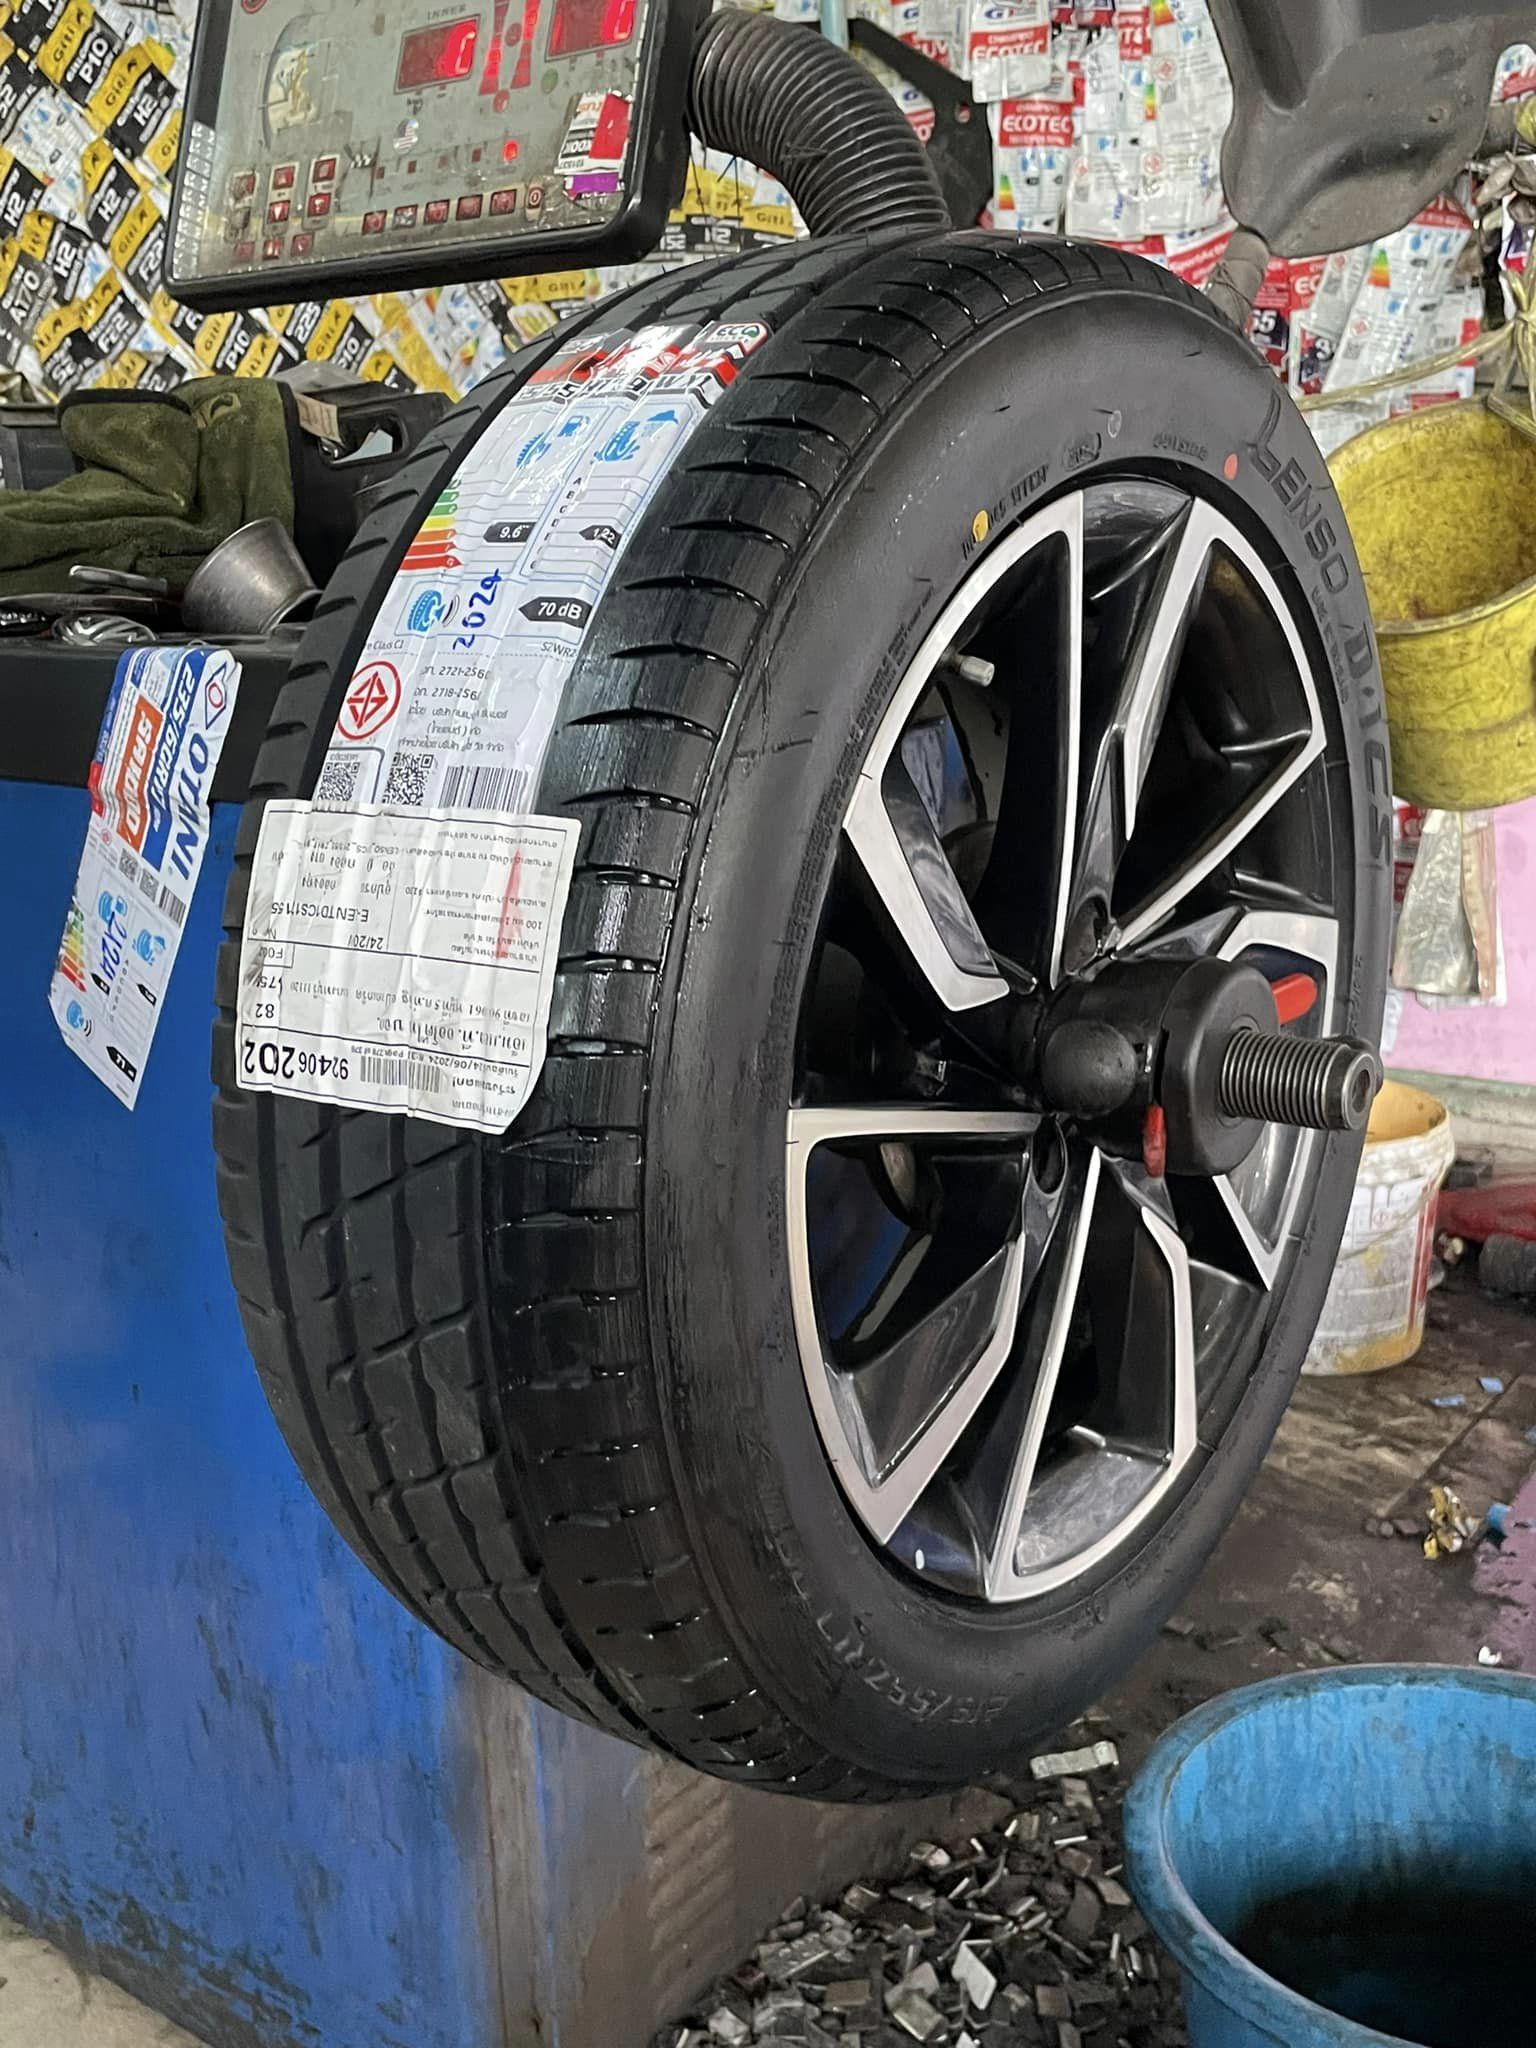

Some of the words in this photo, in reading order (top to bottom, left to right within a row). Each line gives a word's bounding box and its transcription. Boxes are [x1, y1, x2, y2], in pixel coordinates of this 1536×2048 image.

[78, 38, 109, 85] P10
[133, 93, 158, 127] H2
[1002, 114, 1071, 133] ECOTEC
[4, 191, 25, 227] H2
[98, 187, 122, 222] H2
[53, 240, 78, 278] H2
[9, 268, 40, 326] AT70
[225, 329, 250, 370] P10
[453, 568, 502, 650] 2024
[537, 602, 556, 616] 70
[558, 602, 582, 620] dB
[171, 732, 209, 881] OTANI
[255, 1003, 275, 1019] 82
